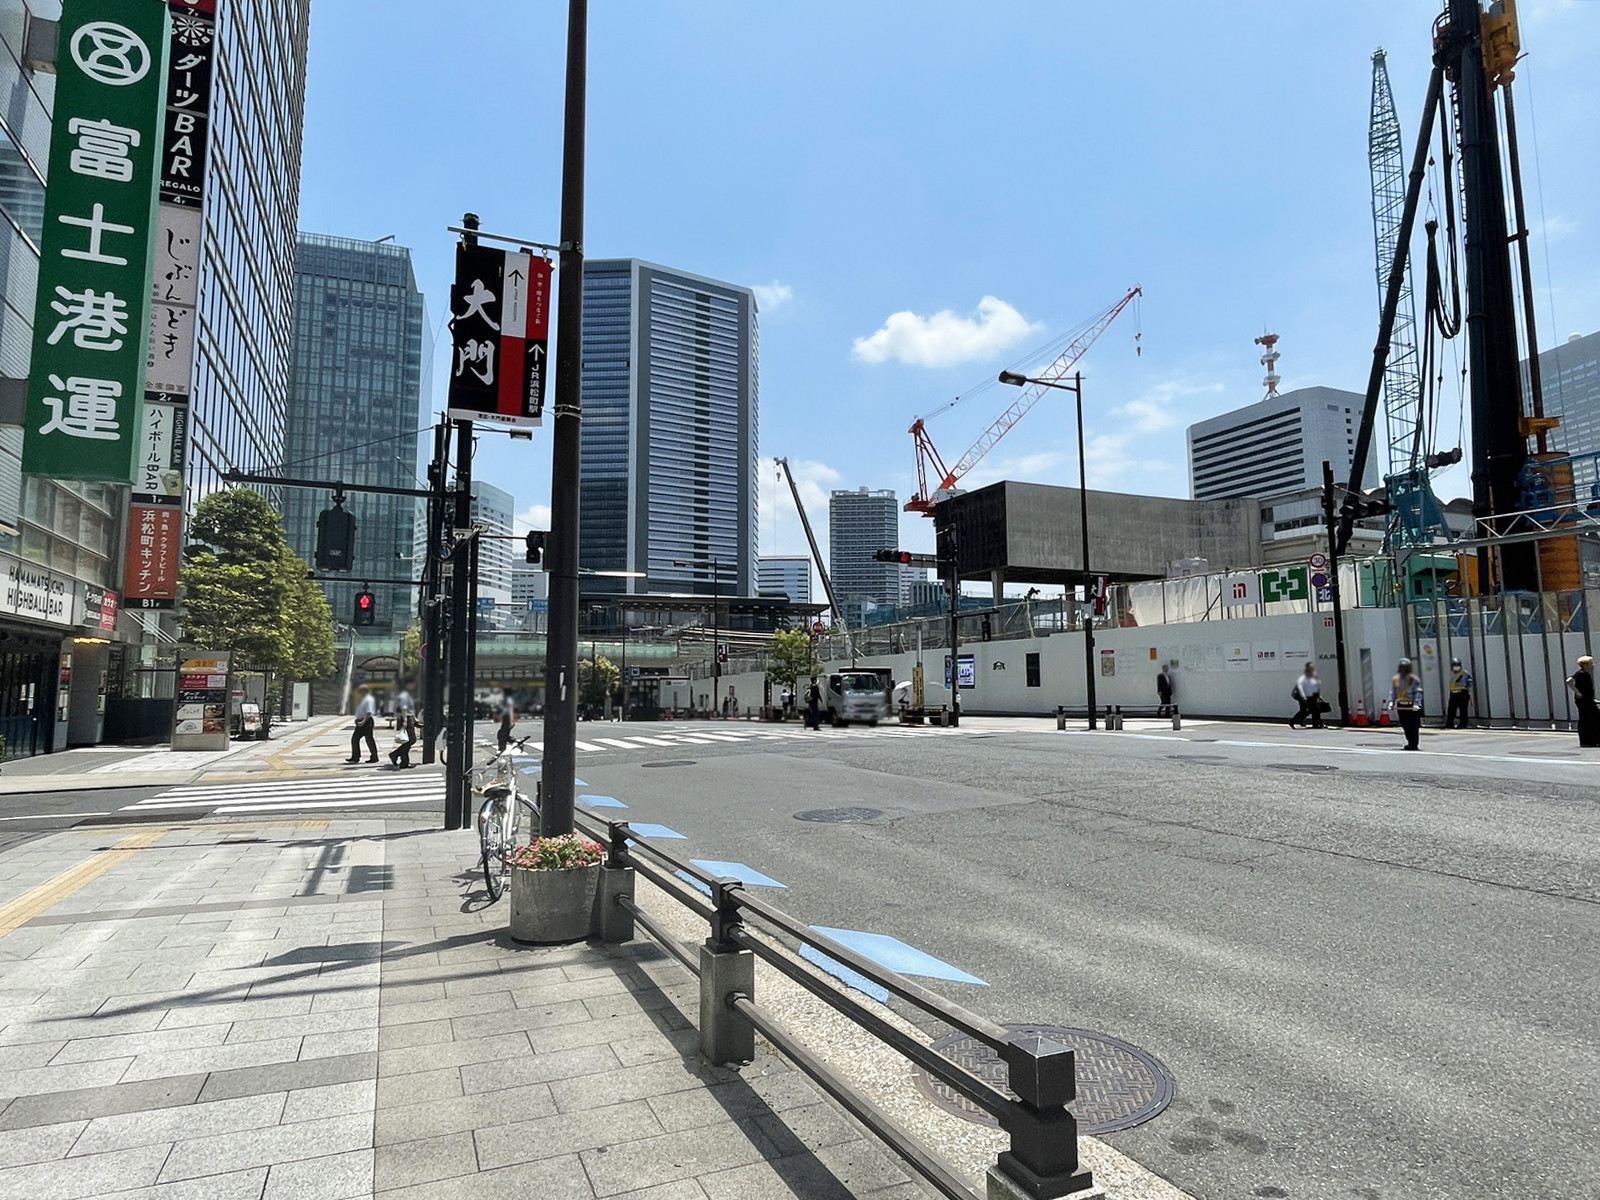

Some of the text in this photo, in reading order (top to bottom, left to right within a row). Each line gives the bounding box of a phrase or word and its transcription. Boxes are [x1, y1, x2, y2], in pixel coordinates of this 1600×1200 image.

[159, 180, 201, 193] REGALO
[39, 117, 141, 441] 富士港運
[455, 279, 501, 386] 大門
[139, 510, 156, 593] 浜松町キッチン
[7, 587, 47, 613] HIGHBALL
[49, 599, 63, 617] BAR
